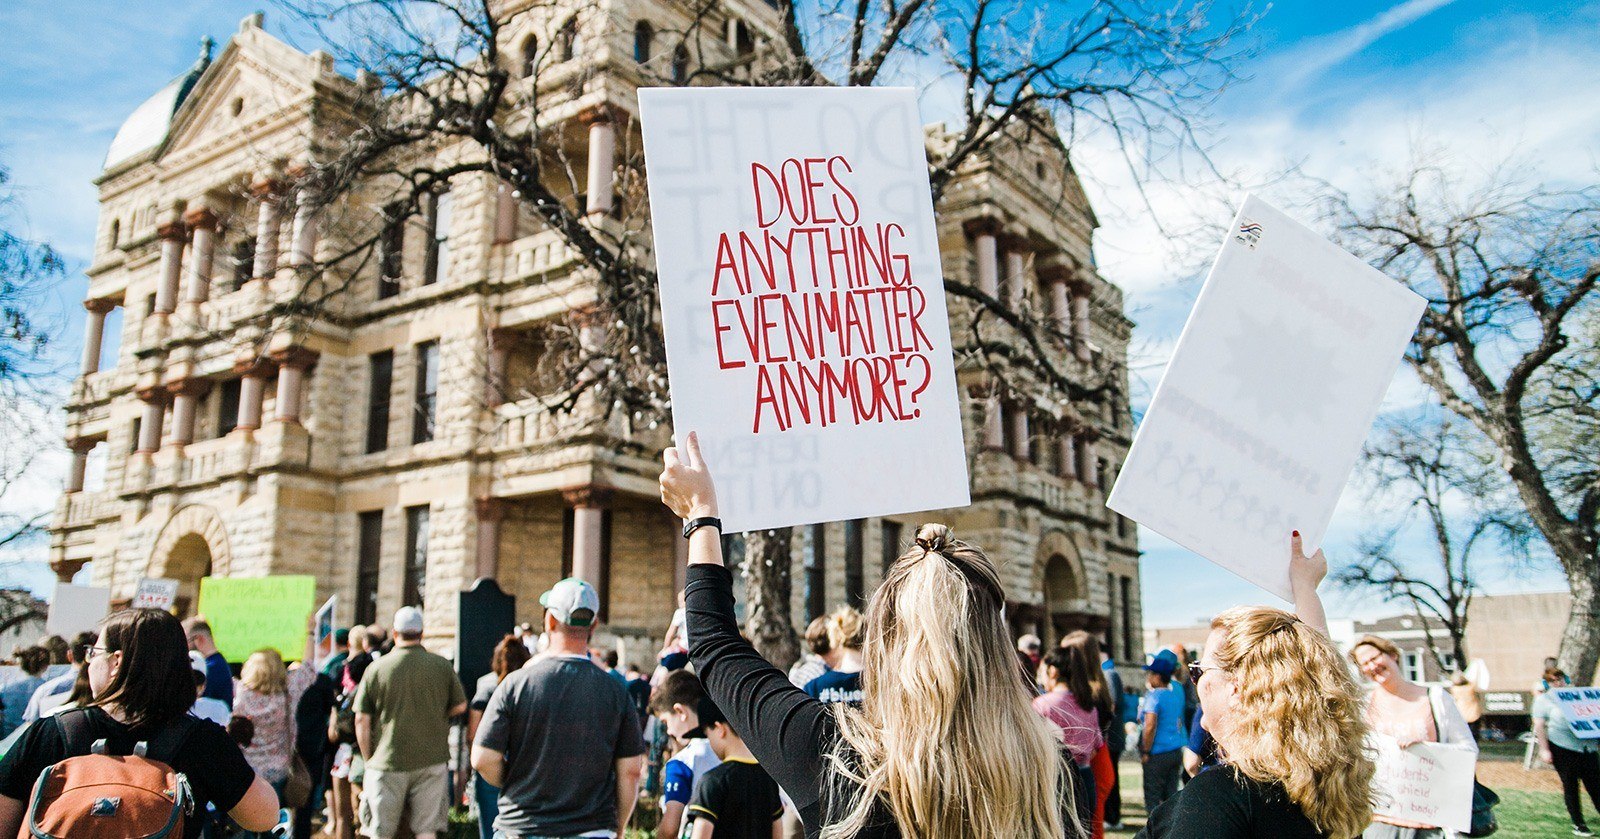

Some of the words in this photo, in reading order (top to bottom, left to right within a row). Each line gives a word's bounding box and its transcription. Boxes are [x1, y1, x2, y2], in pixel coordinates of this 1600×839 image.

[751, 155, 859, 228] DOES
[711, 223, 912, 296] ANYTHING
[712, 293, 816, 369] EVEN
[814, 286, 934, 358] MATTER
[753, 354, 932, 434] ANYMORE?
